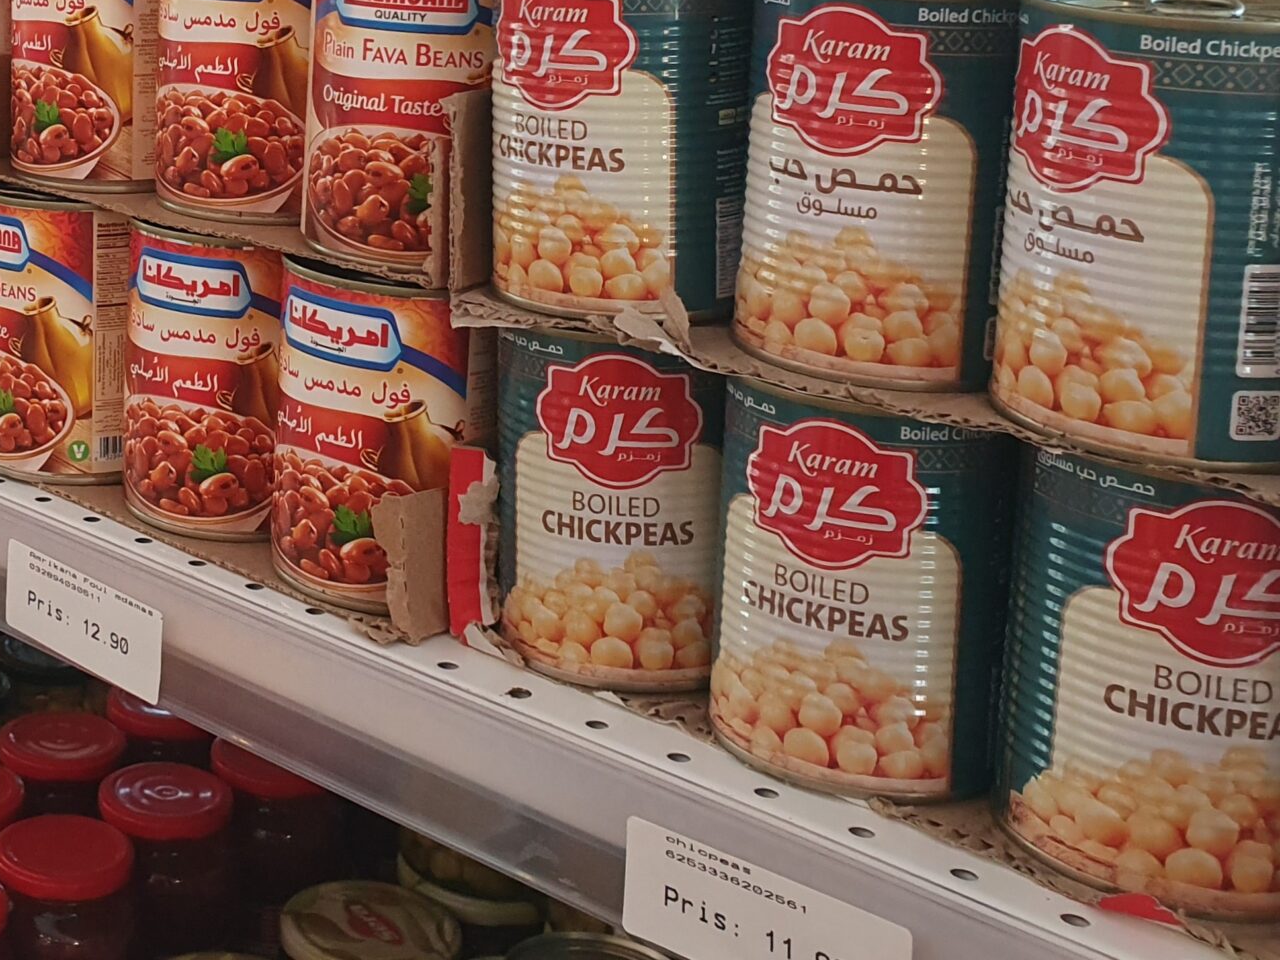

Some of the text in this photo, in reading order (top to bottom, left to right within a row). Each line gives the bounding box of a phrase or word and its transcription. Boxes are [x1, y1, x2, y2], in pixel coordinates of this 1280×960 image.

[183, 11, 282, 35] فول مدمس
[374, 9, 428, 23] QUALITY
[917, 7, 969, 24] Boiled
[323, 31, 485, 70] Plain FAVA BEANS
[504, 28, 608, 78] كرم
[803, 28, 892, 63] Karam
[1140, 34, 1201, 55] Boiled
[194, 57, 239, 84] الطعم
[1033, 50, 1111, 91] Karam
[323, 83, 444, 117] Original Taste
[775, 63, 910, 119] كرم
[514, 112, 588, 141] BOILED
[1016, 88, 1130, 153] كرم
[498, 134, 626, 173] CHICKPEAS
[769, 157, 924, 196] حمص حب
[796, 192, 879, 221] مسلوق
[1038, 204, 1146, 244] حمص
[1023, 229, 1096, 264] مسلوق
[160, 324, 217, 345] مدمس
[225, 327, 261, 353] فول
[171, 372, 219, 397] الطعم
[304, 372, 362, 398] مدمس
[371, 382, 412, 409] فول
[577, 375, 662, 408] Karam
[314, 430, 364, 451] الطعم
[554, 407, 681, 457] كرم
[899, 425, 949, 442] Boiled
[787, 440, 879, 479] Karam
[1099, 471, 1157, 497] حمص
[572, 490, 661, 518] BOILED
[760, 472, 898, 533] كرم
[541, 509, 695, 547] CHICKPEAS
[29, 551, 78, 580] Amrikana
[83, 576, 109, 595] Foul
[773, 562, 870, 606] BOILED
[27, 589, 130, 656] Pris: 12.90
[743, 579, 910, 642] CHICKPEAS
[1152, 663, 1274, 705] BOILED
[665, 835, 753, 875] chicpeas
[663, 885, 741, 938] Pris:
